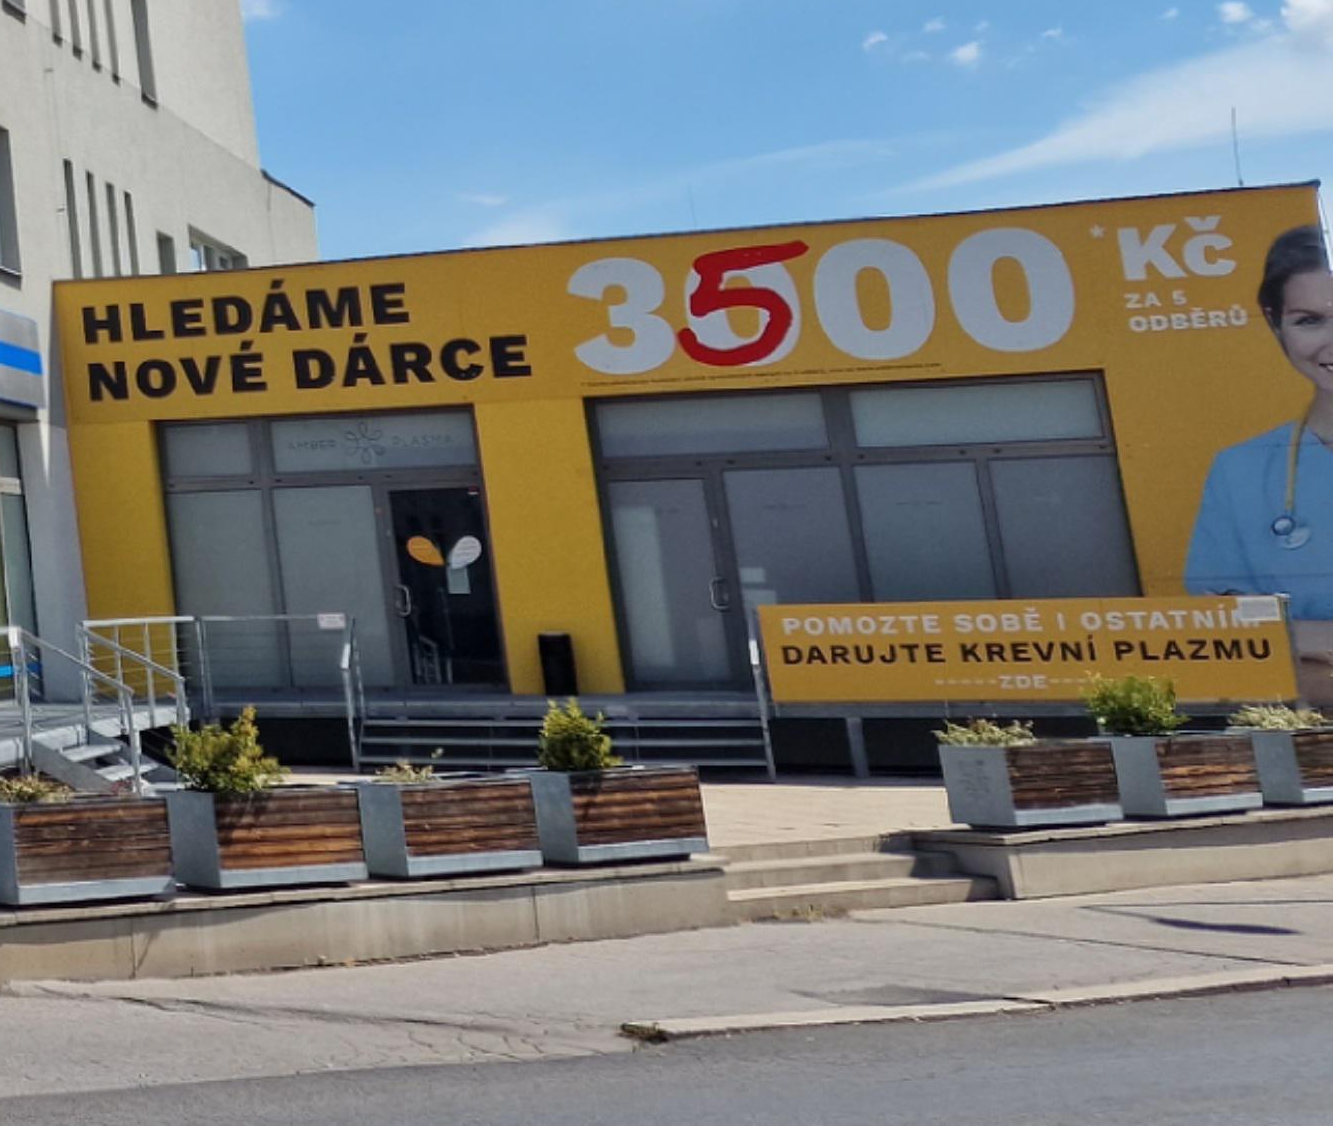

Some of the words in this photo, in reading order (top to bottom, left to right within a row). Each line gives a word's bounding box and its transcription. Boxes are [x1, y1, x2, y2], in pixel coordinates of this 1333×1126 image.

[565, 226, 1076, 374] 3500
[1117, 214, 1237, 281] Kč
[1123, 291, 1162, 309] ZA
[1172, 289, 1187, 306] 5
[81, 278, 410, 345] HLEDÁME
[1129, 304, 1248, 333] ODBĚRŮ
[87, 340, 268, 402] NOVÉ
[292, 332, 532, 390] DÁRCE
[781, 614, 942, 637] POMOZTE
[952, 606, 1044, 634] SOBĚ
[1057, 612, 1067, 631] I
[781, 643, 947, 665] DARUJTE
[959, 634, 1097, 663] KREVNÍ
[1112, 638, 1272, 662] PLAZMU
